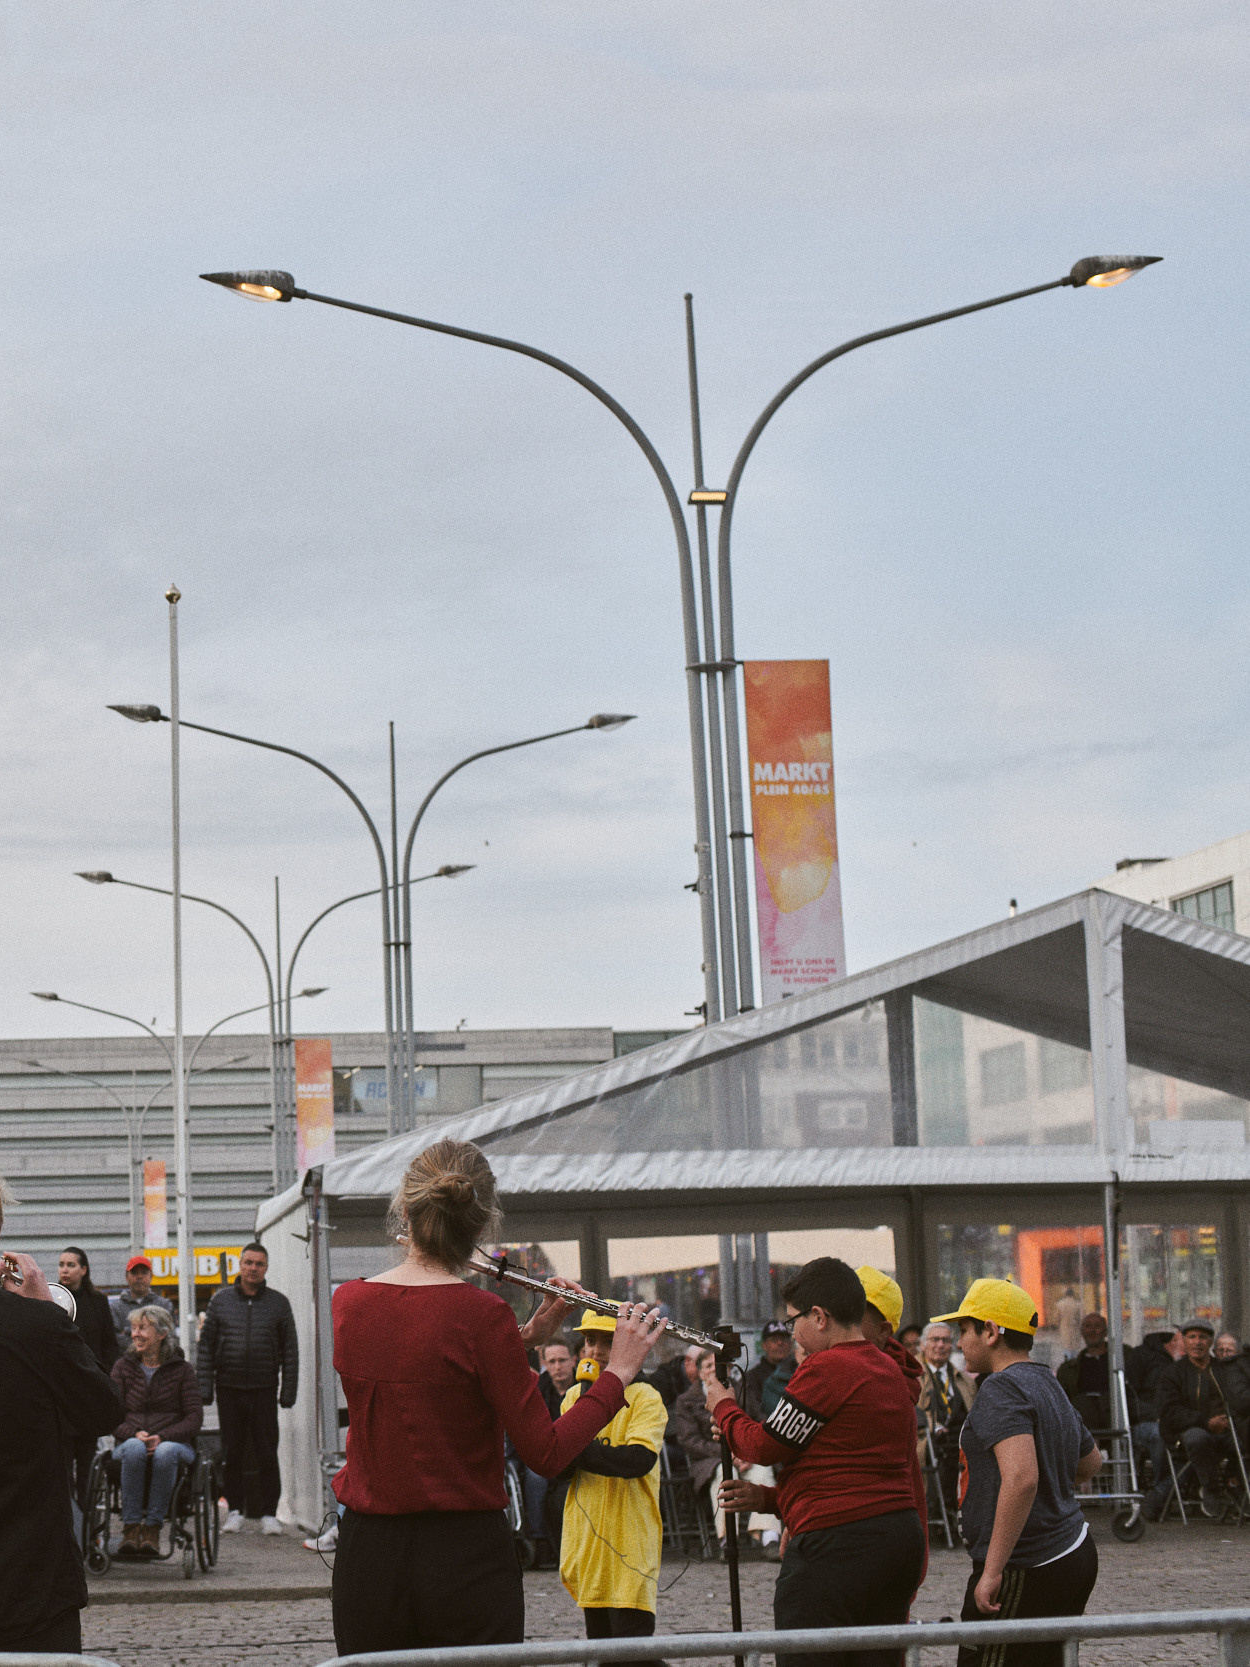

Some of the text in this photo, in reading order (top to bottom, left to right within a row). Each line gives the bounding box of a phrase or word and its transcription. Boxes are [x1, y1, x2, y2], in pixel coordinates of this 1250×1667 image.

[754, 762, 830, 782] MARKT
[755, 784, 830, 796] PLEIN 40/45
[148, 1254, 241, 1278] UBO
